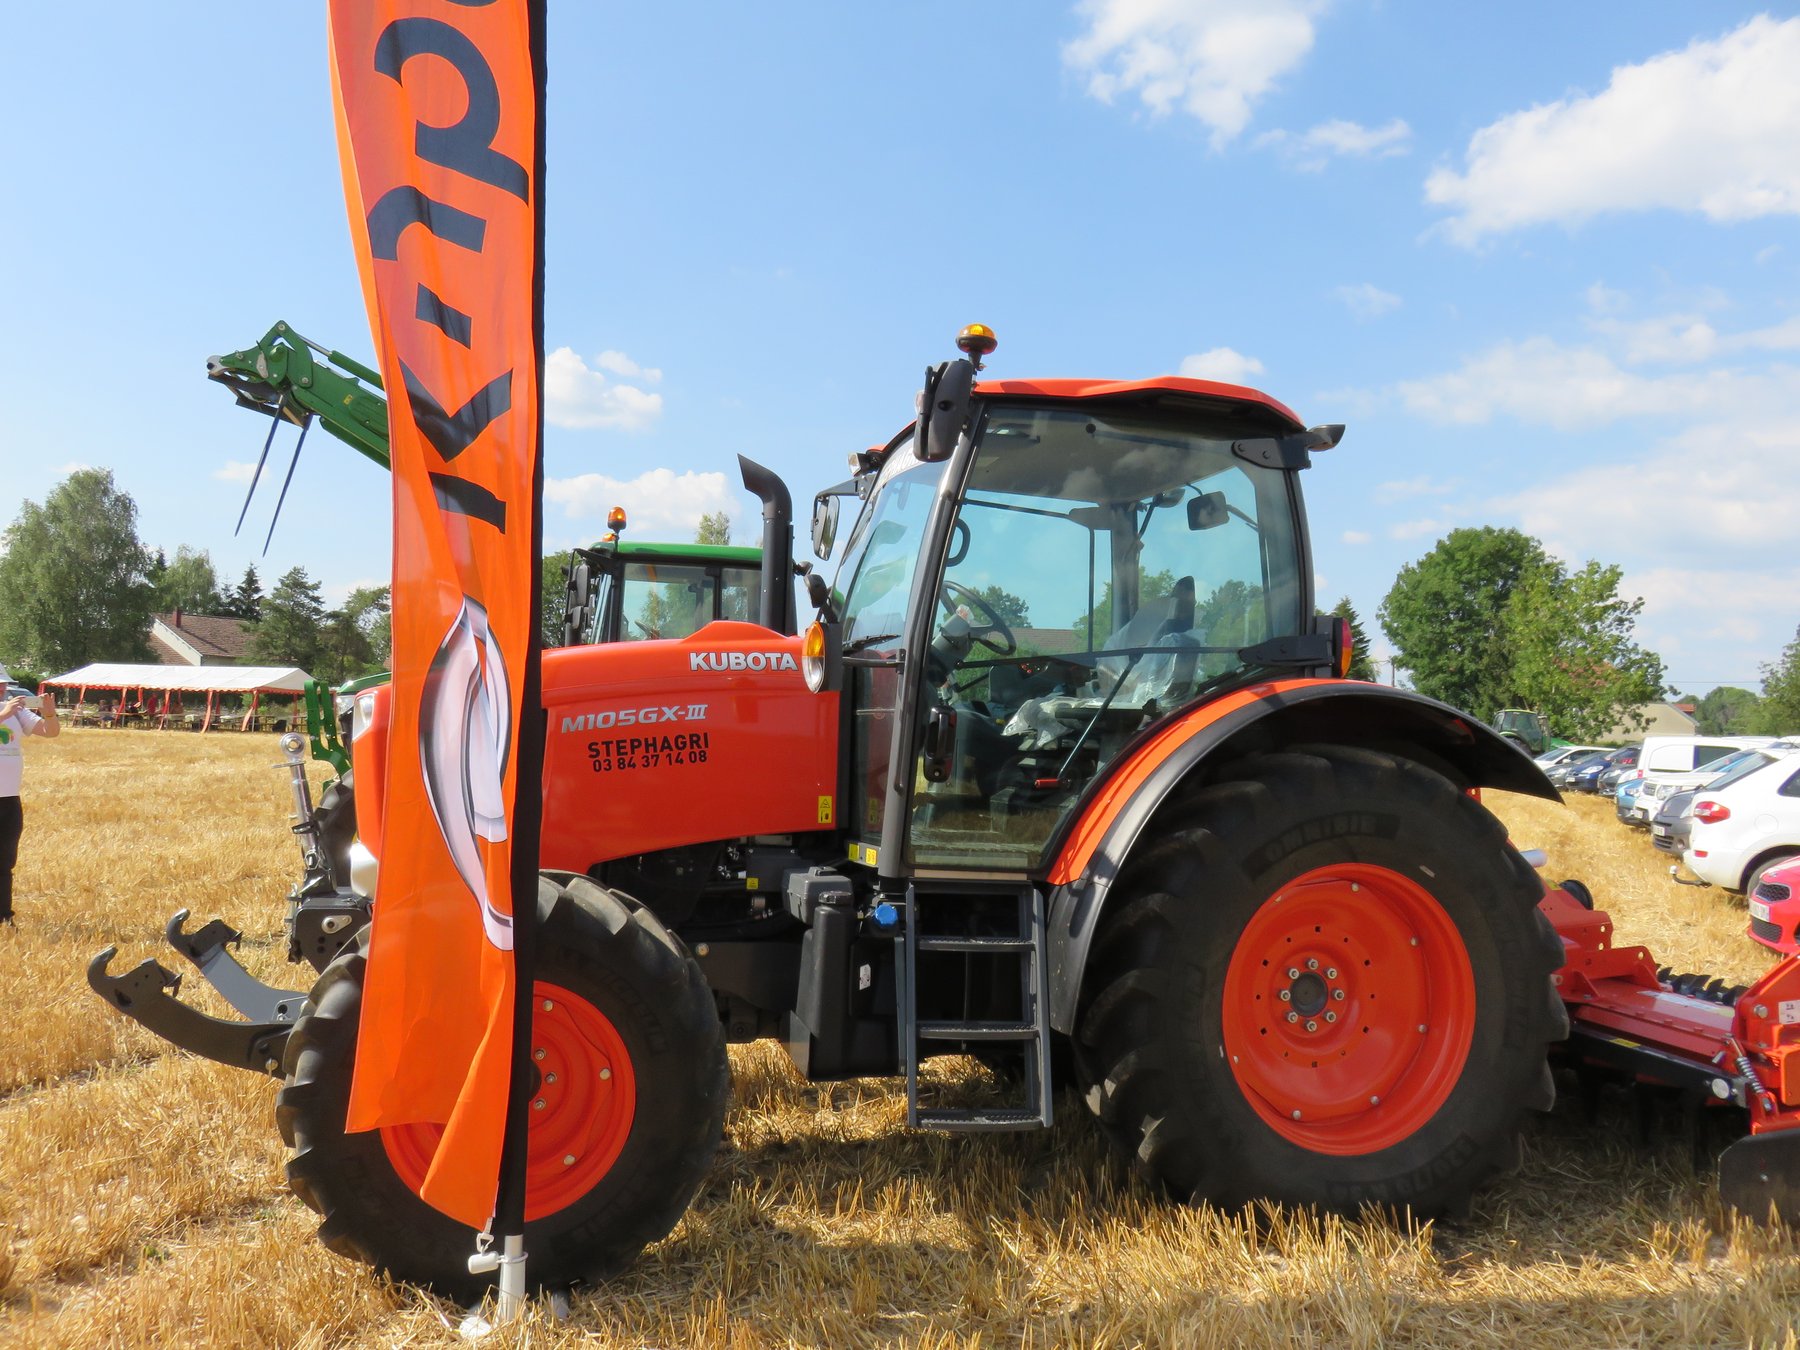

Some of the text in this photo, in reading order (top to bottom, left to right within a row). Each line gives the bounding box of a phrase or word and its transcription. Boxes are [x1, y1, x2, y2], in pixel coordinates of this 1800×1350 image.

[689, 651, 799, 672] KUBOTA
[561, 704, 708, 734] M105GX-III
[587, 732, 709, 759] STEPHAGRI
[592, 750, 708, 772] 03 84 37 14 08
